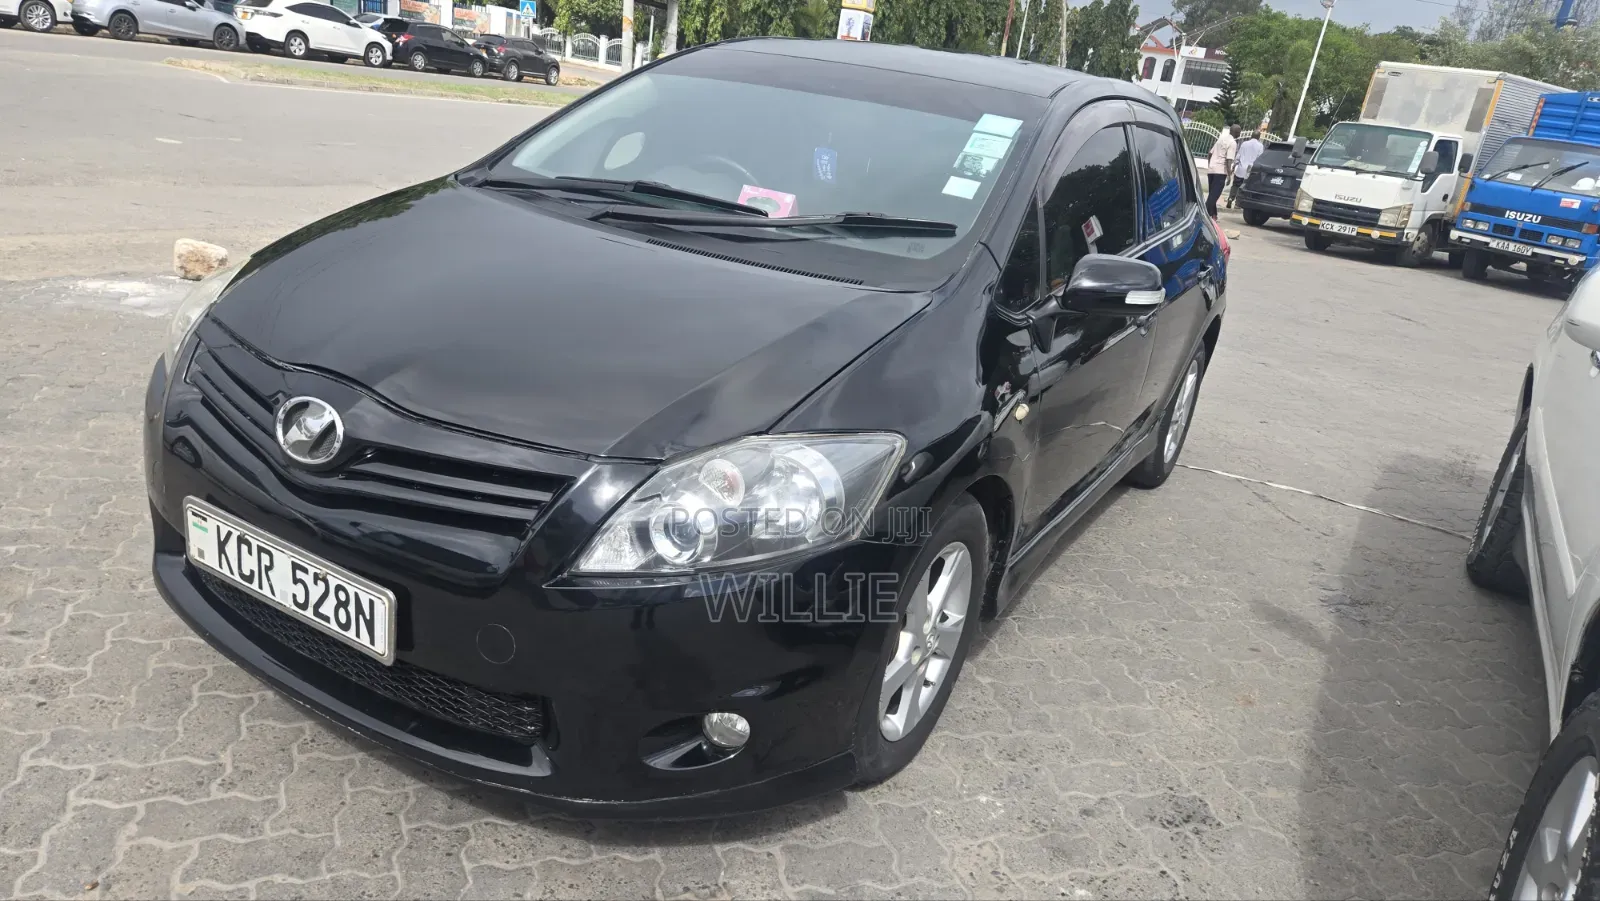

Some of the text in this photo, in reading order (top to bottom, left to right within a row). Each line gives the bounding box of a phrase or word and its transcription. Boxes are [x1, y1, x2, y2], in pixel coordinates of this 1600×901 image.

[1334, 193, 1363, 204] ISUZU
[1504, 209, 1542, 224] ISUZU
[1320, 221, 1356, 234] KCX 291P
[1495, 240, 1510, 251] KAA
[216, 524, 376, 647] KCR 528N
